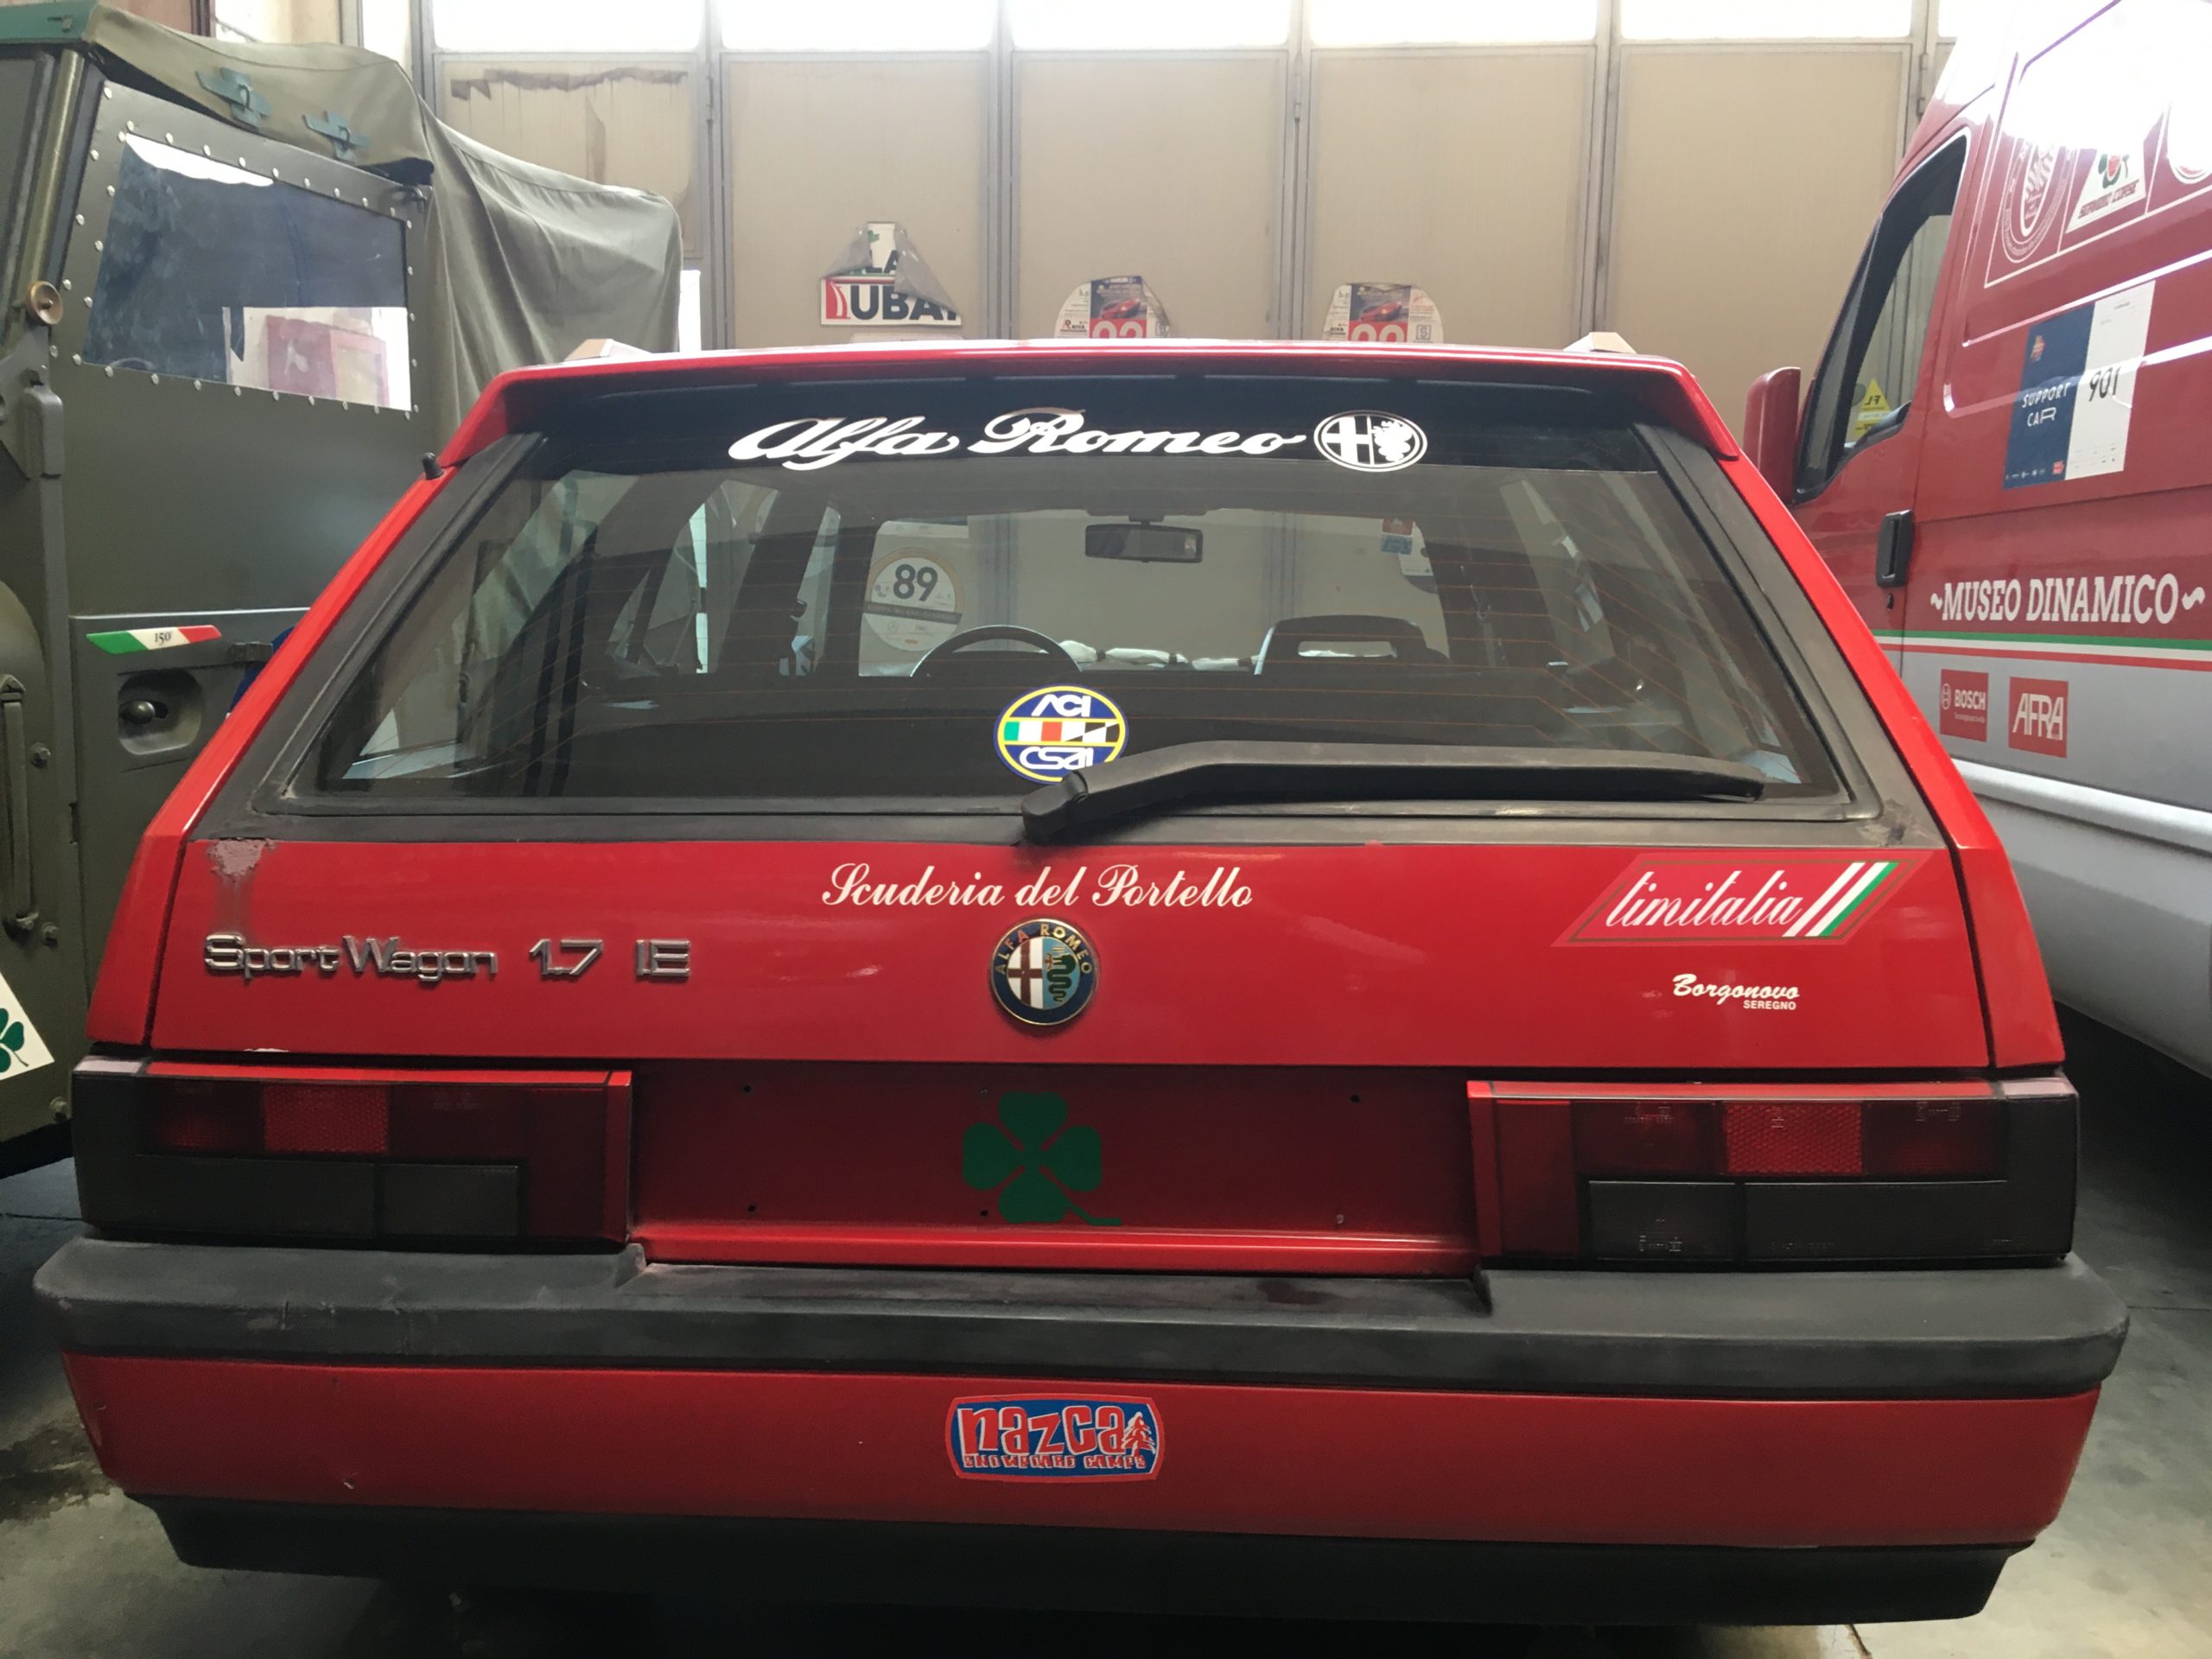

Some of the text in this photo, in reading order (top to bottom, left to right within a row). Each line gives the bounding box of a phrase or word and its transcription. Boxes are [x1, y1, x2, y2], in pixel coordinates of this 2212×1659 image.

[2022, 382, 2071, 408] SUPPORT
[2088, 366, 2121, 402] 901
[2027, 407, 2056, 427] CAR
[728, 407, 1306, 471] Alfa Romeo
[893, 563, 938, 601] 89
[1942, 573, 2179, 624] MUSEO DINAMICO
[1031, 694, 1091, 717] ACI
[1954, 689, 1986, 710] BOSCH
[2012, 693, 2064, 741] AFRA
[822, 862, 1253, 907] Scuderia del Portello
[636, 938, 690, 976] IE
[995, 924, 1093, 975] ALFA ROMEO
[1672, 973, 1800, 1005] Borgonovo
[1743, 1000, 1797, 1010] SEREGNO
[963, 1453, 1147, 1470] SNOWBOARD CAMPS
